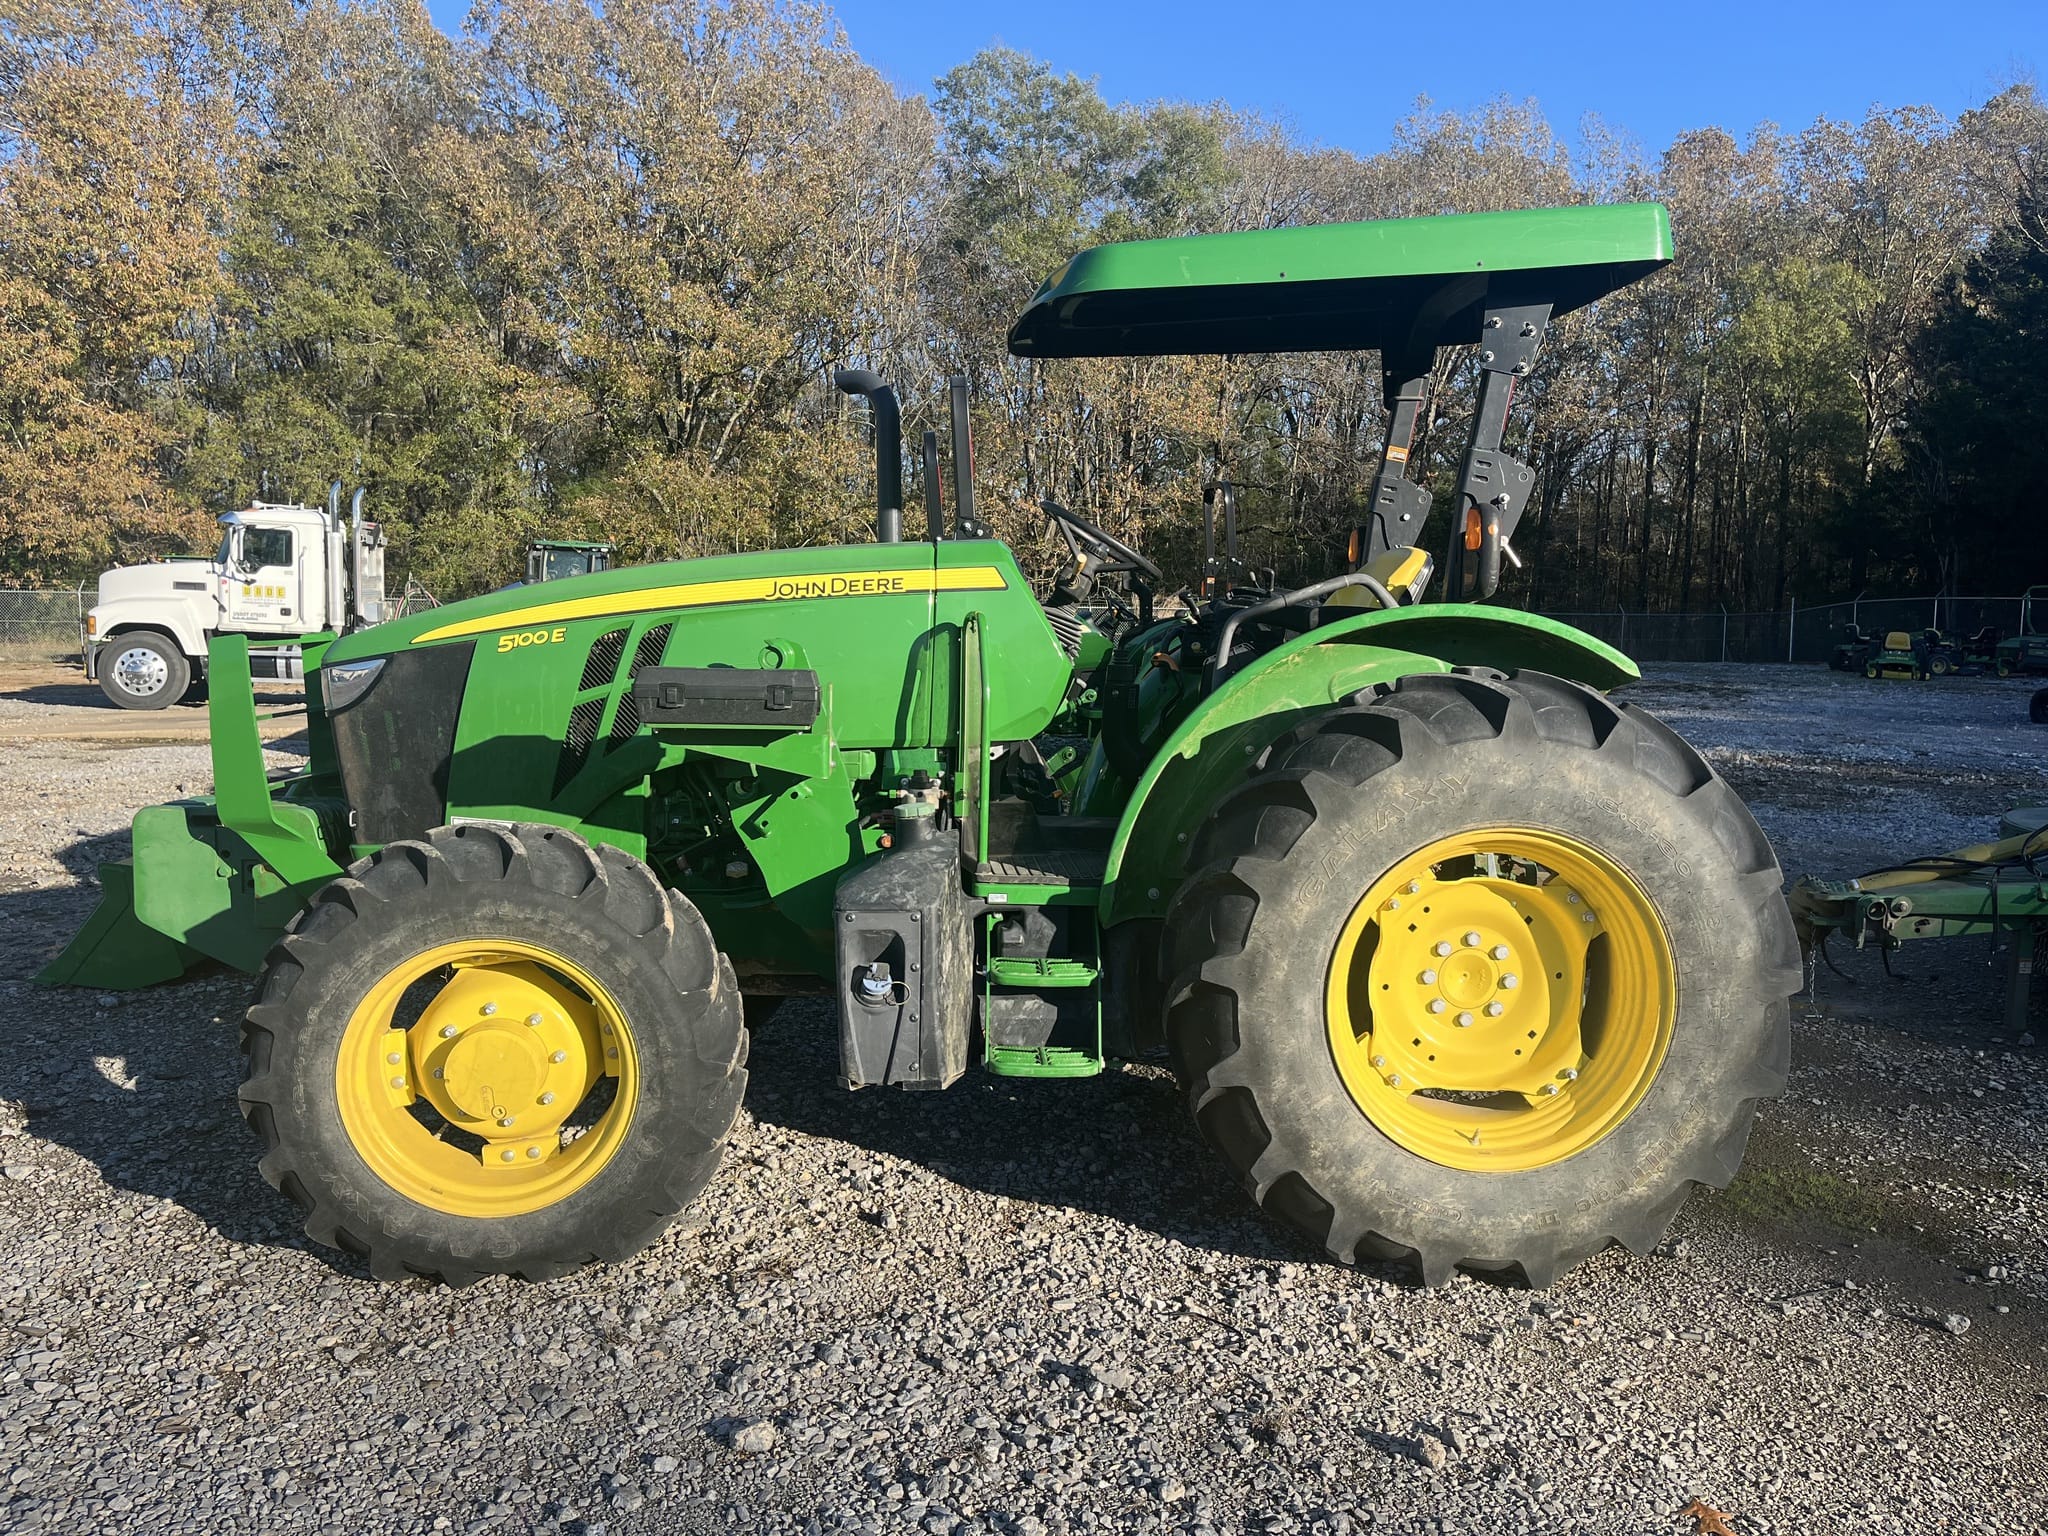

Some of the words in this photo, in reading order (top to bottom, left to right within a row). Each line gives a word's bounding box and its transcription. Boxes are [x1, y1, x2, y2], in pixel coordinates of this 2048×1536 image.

[765, 581, 826, 598] JOHN
[831, 577, 904, 594] DEERE
[497, 631, 549, 654] 5100
[551, 627, 567, 643] E
[1297, 773, 1472, 904] GALAXY
